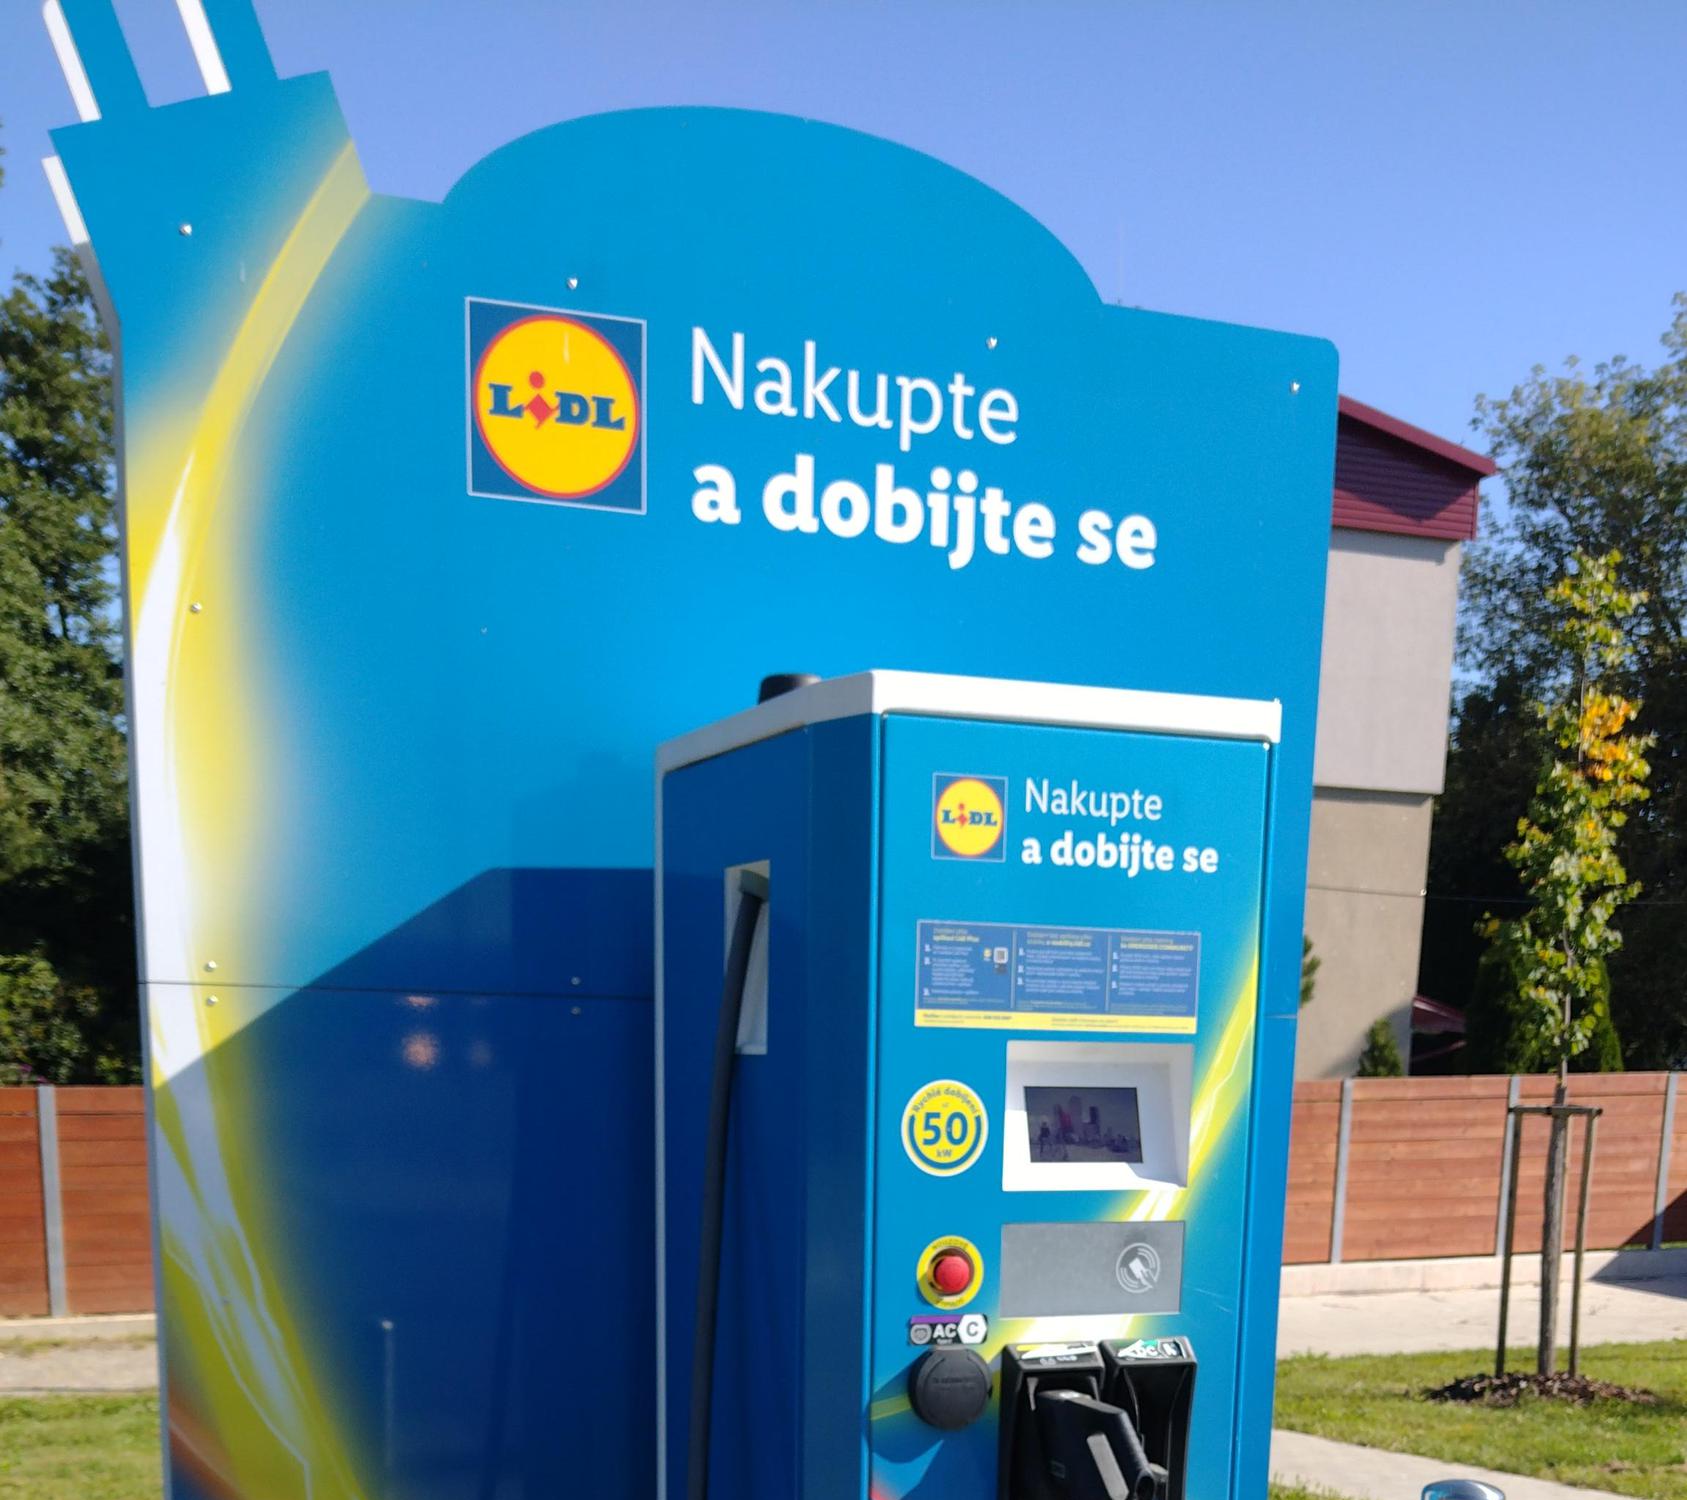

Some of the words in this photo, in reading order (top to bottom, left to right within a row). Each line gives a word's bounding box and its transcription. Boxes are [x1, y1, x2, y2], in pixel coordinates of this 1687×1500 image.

[691, 326, 1020, 452] Nakupte
[691, 463, 742, 525] a
[762, 453, 1057, 571] dobijte
[1076, 510, 1158, 571] se
[1024, 777, 1164, 827] Nakupte
[1021, 837, 1043, 865] a
[1049, 830, 1174, 879] dobijte
[1181, 845, 1219, 874] se
[923, 1112, 968, 1146] 50
[936, 1148, 953, 1158] kW
[933, 1322, 957, 1339] AC
[966, 1321, 979, 1337] C
